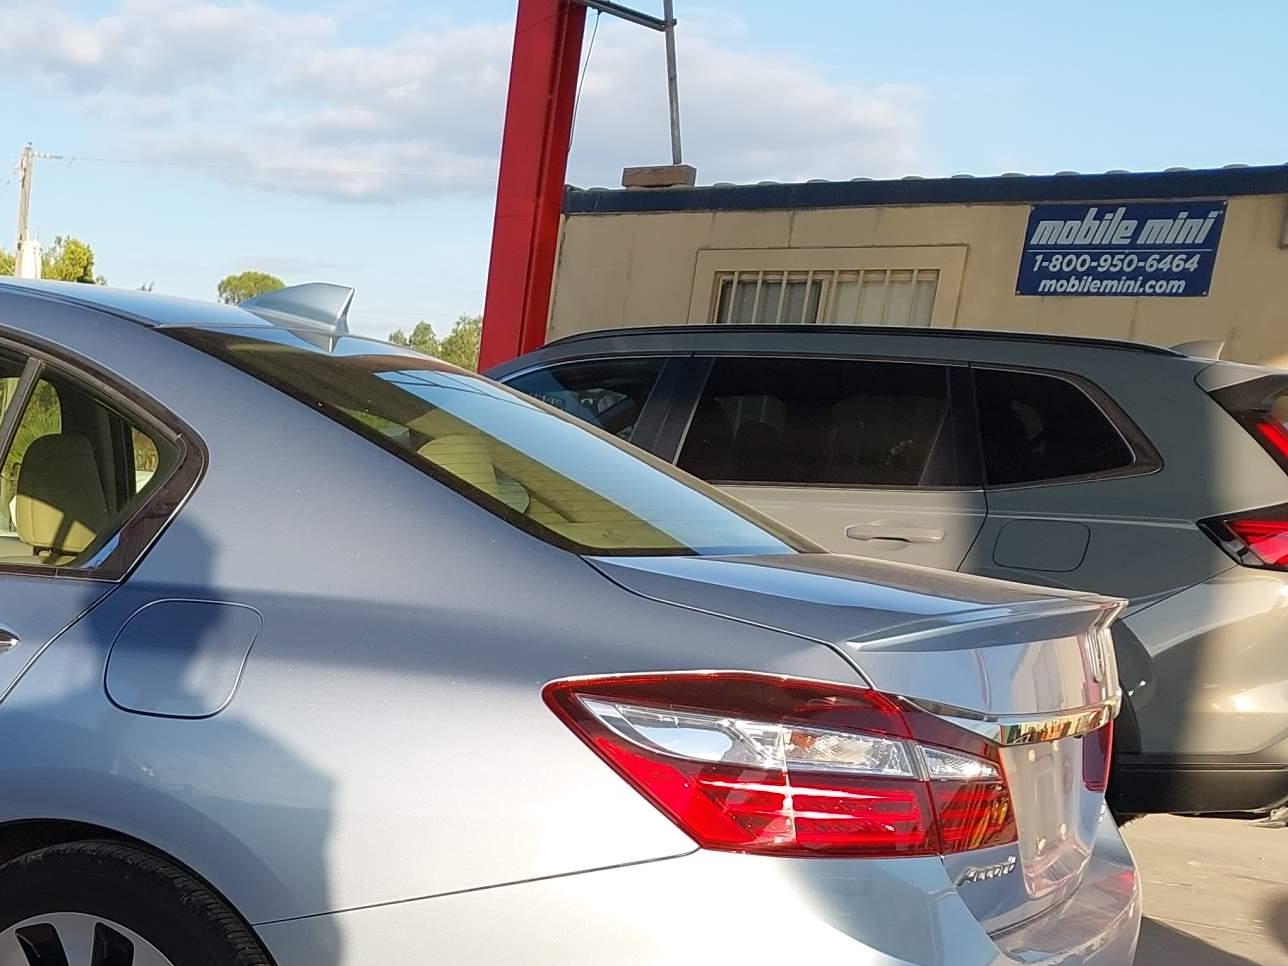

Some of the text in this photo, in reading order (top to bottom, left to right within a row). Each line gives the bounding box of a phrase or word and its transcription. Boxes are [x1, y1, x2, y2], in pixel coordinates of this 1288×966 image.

[1030, 207, 1218, 245] mobile mini
[1033, 254, 1200, 272] 1-800-950-6464
[1038, 276, 1186, 293] mobilemini.com
